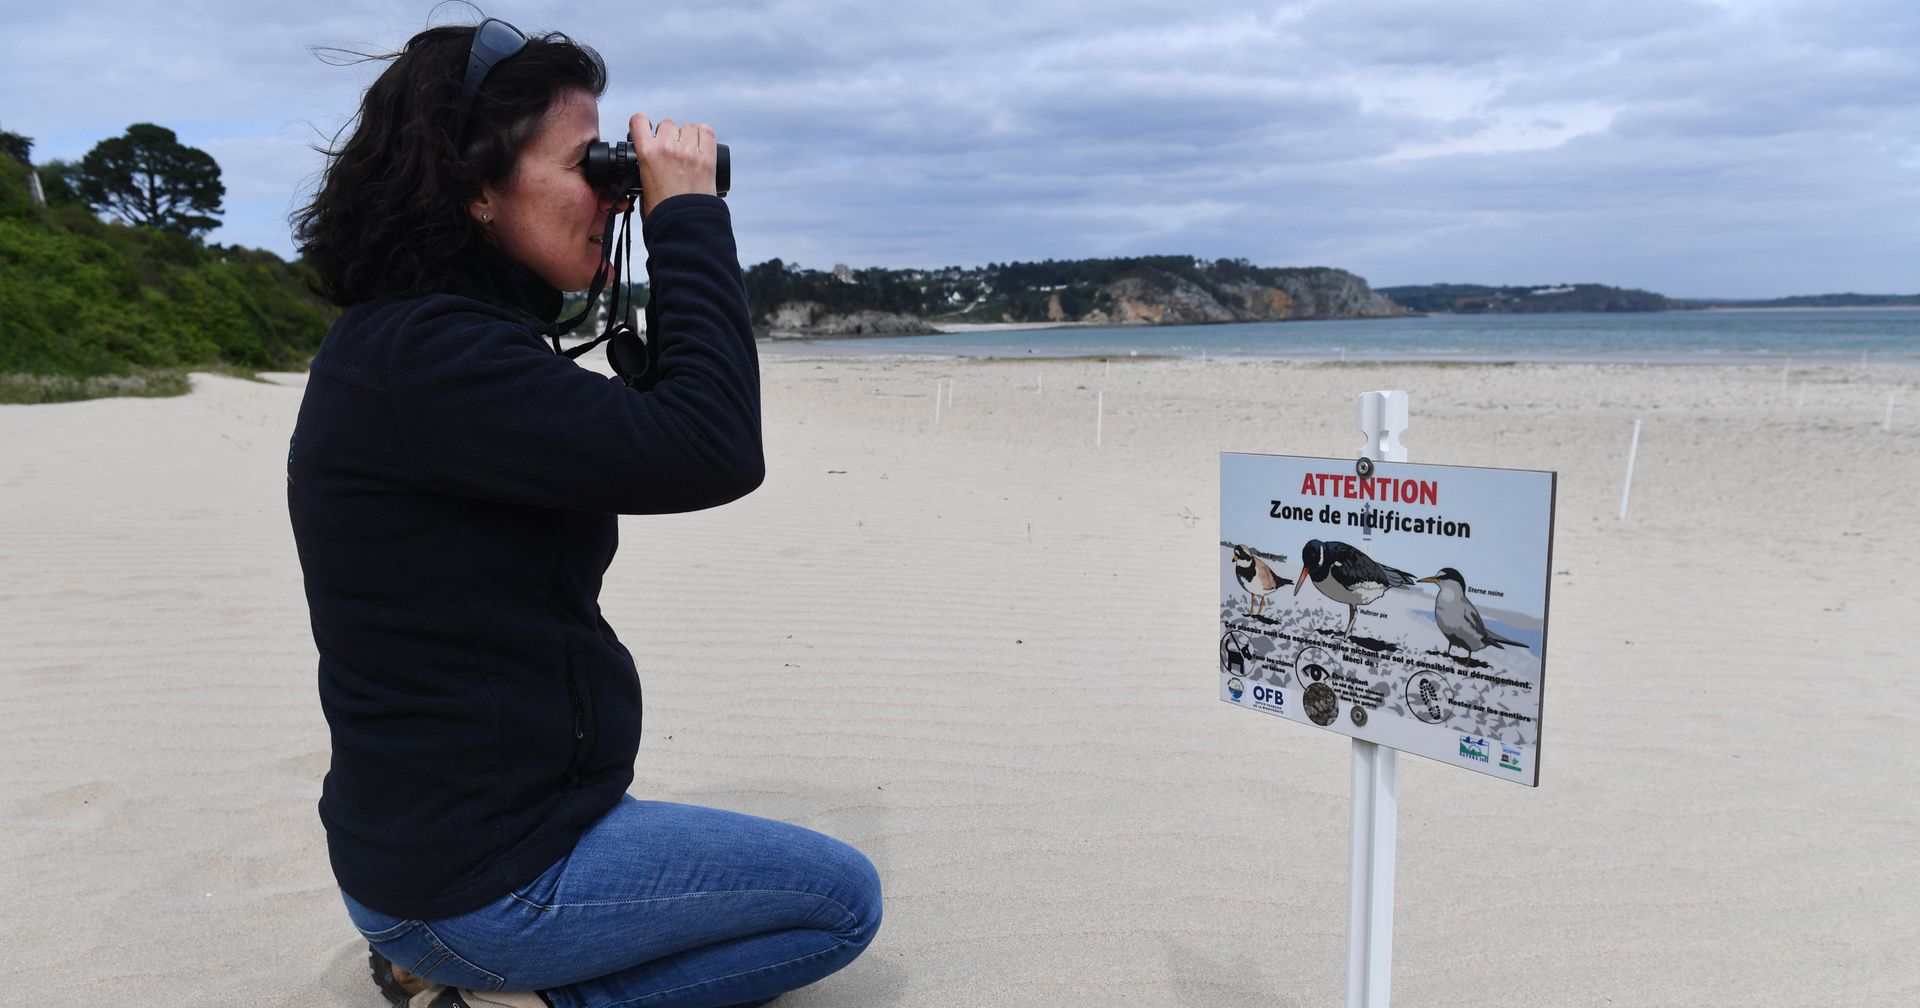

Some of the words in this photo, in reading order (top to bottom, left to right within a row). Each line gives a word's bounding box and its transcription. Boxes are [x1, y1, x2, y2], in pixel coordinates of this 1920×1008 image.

[1301, 472, 1438, 506] ATTENTION
[1270, 500, 1313, 522] Zone
[1319, 505, 1341, 525] de
[1347, 508, 1471, 538] nidification
[1468, 586, 1486, 595] Sterne
[1225, 621, 1236, 629] Ces
[1238, 624, 1261, 634] oiseaux
[1263, 630, 1278, 638] sont
[1279, 631, 1291, 640] des
[1292, 635, 1321, 648] espèces
[1322, 640, 1349, 652] fragiles
[1351, 647, 1379, 658] nichant
[1381, 653, 1390, 661] au
[1392, 655, 1404, 663] sol
[1416, 661, 1455, 673] sensibles
[1470, 671, 1532, 689] dérangement.
[1276, 660, 1294, 668] chiens
[1343, 655, 1363, 665] Merci
[1270, 665, 1285, 673] laisse
[1253, 685, 1284, 705] OFB
[1448, 698, 1472, 710] Rester
[1473, 704, 1485, 712] sur
[1487, 706, 1498, 715] les
[1500, 710, 1531, 722] sentiers
